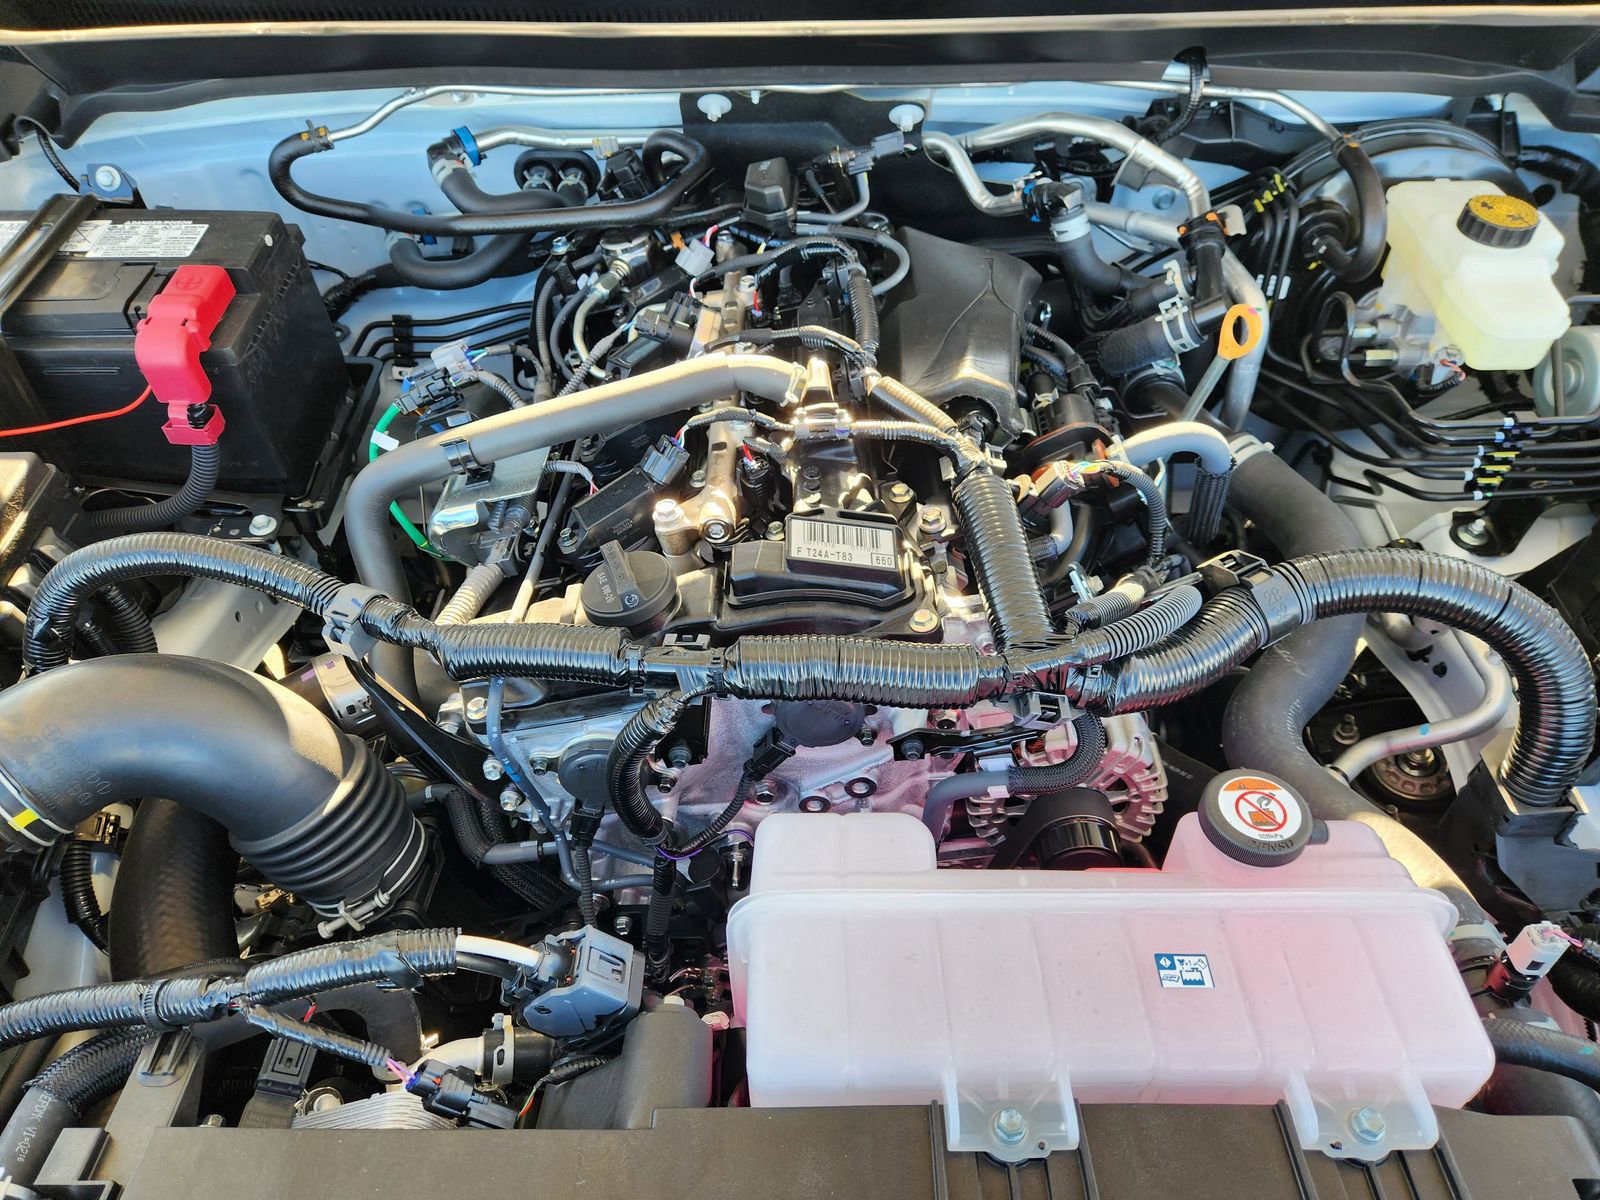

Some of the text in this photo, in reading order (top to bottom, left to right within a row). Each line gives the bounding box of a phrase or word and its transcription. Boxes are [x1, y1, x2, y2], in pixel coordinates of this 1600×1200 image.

[797, 546, 802, 556] F
[807, 547, 853, 562] T24A-T83
[597, 572, 608, 585] SAE
[1248, 839, 1295, 851] DENSO
